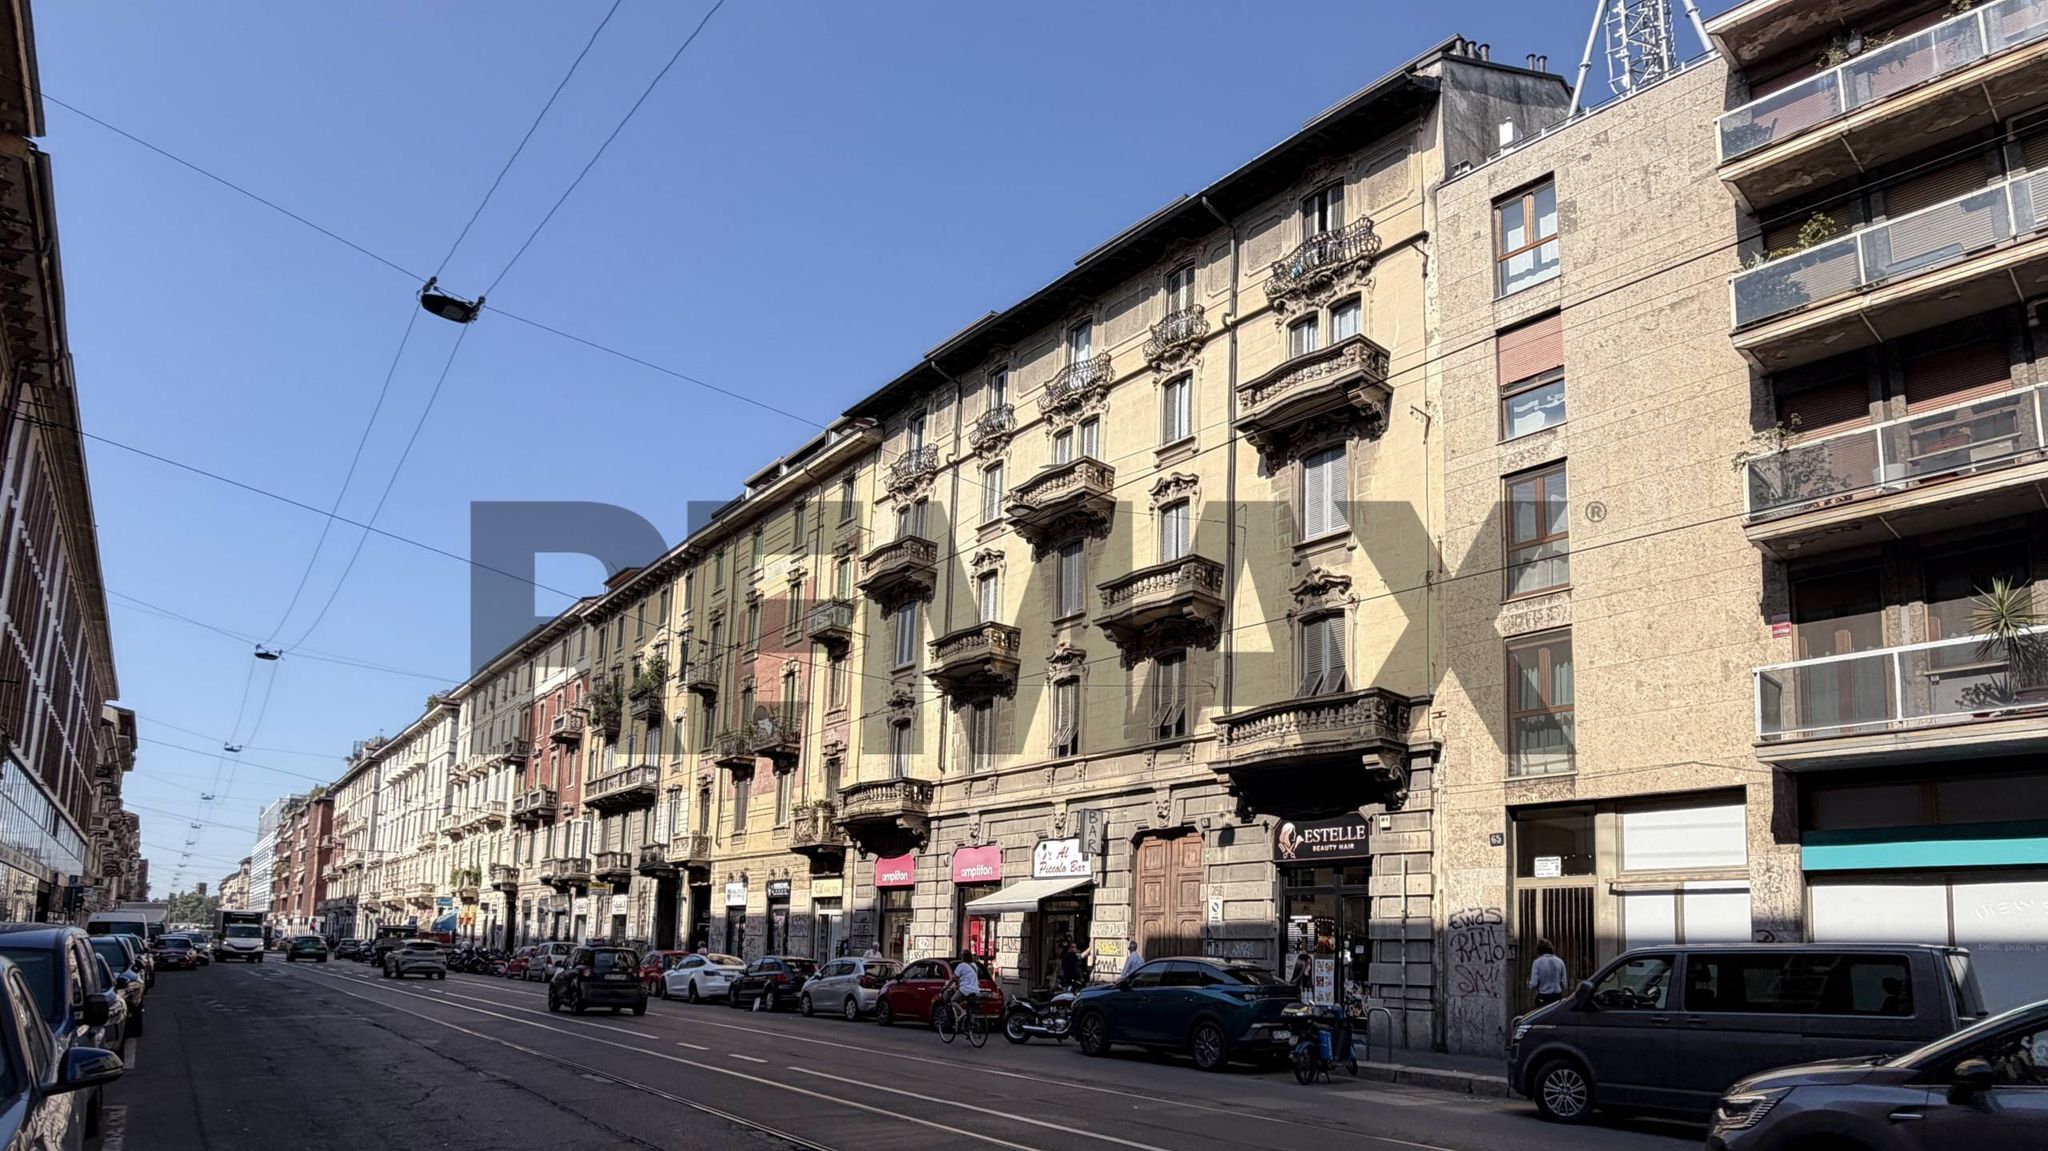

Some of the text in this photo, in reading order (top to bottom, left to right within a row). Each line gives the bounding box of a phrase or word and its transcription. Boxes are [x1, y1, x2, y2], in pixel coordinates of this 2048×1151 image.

[1088, 811, 1098, 852] BAR
[1304, 825, 1366, 843] ESTELLE
[1490, 834, 1502, 844] 65
[1056, 846, 1069, 859] Al
[1312, 843, 1337, 852] BEAUTY
[961, 864, 993, 879] amplifon
[1039, 859, 1086, 874] Piccolo Bar
[881, 870, 908, 882] amplifon
